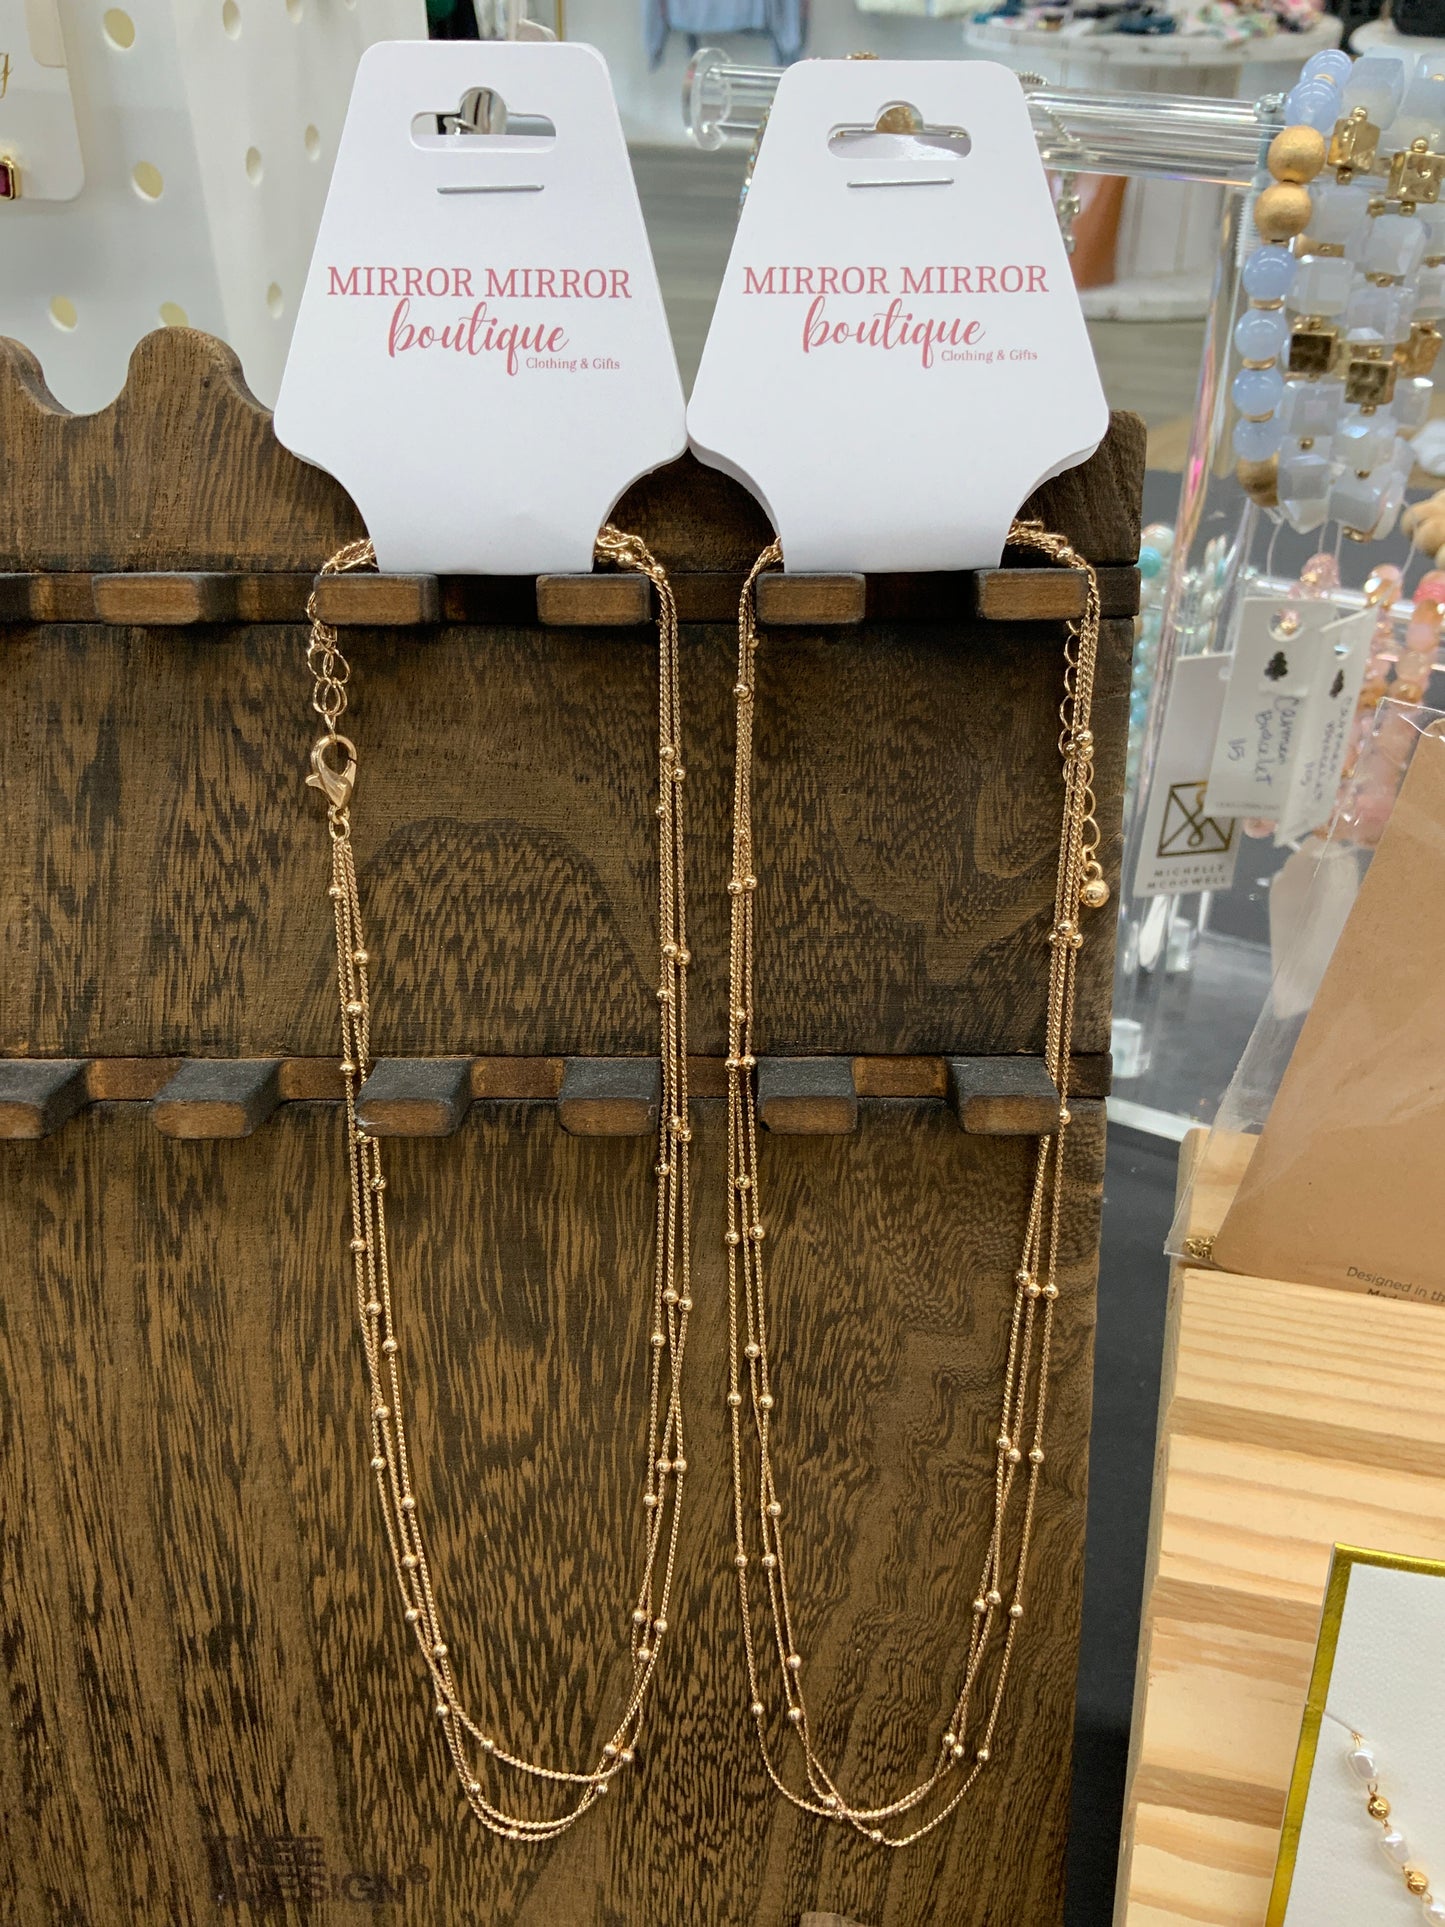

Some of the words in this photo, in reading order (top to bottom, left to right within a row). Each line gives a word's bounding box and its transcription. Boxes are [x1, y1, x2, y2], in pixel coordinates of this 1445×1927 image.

[327, 266, 475, 297] MIRROR
[485, 267, 633, 299] MIRROR
[742, 266, 890, 295] MIRROR
[900, 265, 1049, 294] MIRROR
[388, 297, 570, 377] boutique
[802, 295, 986, 369] boutique
[525, 357, 577, 373] Clothing
[580, 358, 589, 370] &
[592, 357, 621, 370] Gifts
[941, 349, 993, 364] Clothing
[996, 349, 1005, 361] &
[1009, 348, 1038, 361] Gifts
[1346, 1266, 1412, 1292] Designed
[1414, 1284, 1428, 1298] in
